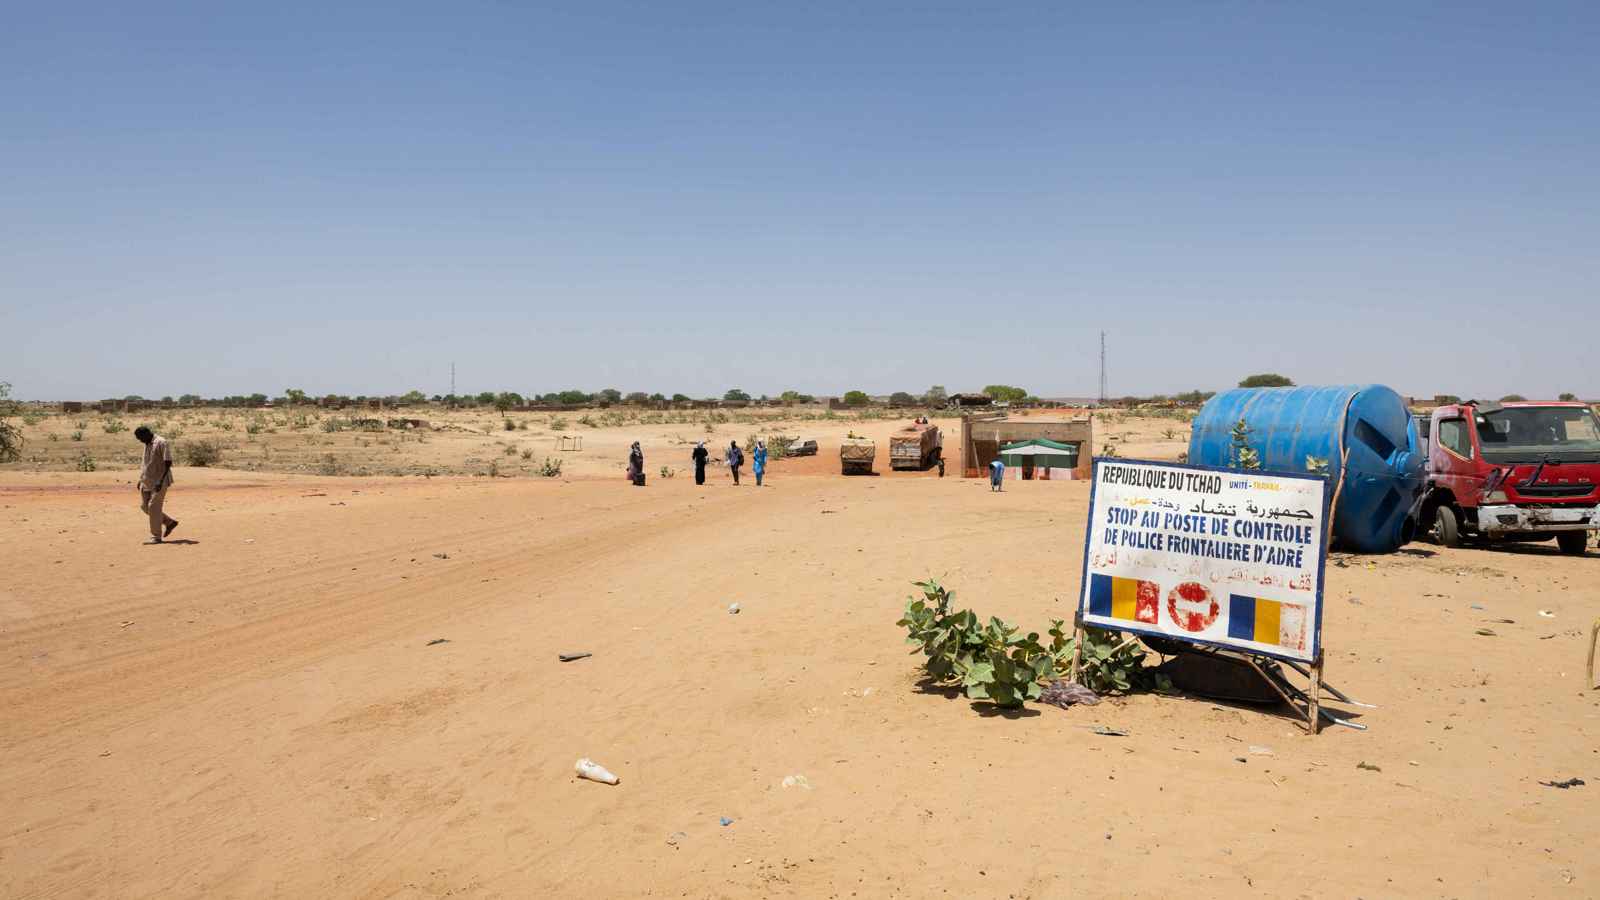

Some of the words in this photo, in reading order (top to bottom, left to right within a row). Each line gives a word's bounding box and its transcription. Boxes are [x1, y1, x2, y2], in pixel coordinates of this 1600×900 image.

[1102, 466, 1167, 489] REPUBLIQUE
[1168, 472, 1185, 491] DU
[1186, 474, 1221, 495] TCHAD
[1190, 498, 1237, 517] تشاد
[1107, 506, 1138, 527] STOP
[1141, 510, 1160, 529] AU
[1164, 512, 1207, 535] POSTE
[1212, 517, 1229, 537] DE
[1233, 520, 1312, 545] CONTROLE
[1104, 527, 1119, 545] DE
[1121, 529, 1164, 551] POLICE
[1167, 534, 1251, 562] FRONTALIERE
[1253, 545, 1304, 569] D'ADRÉ
